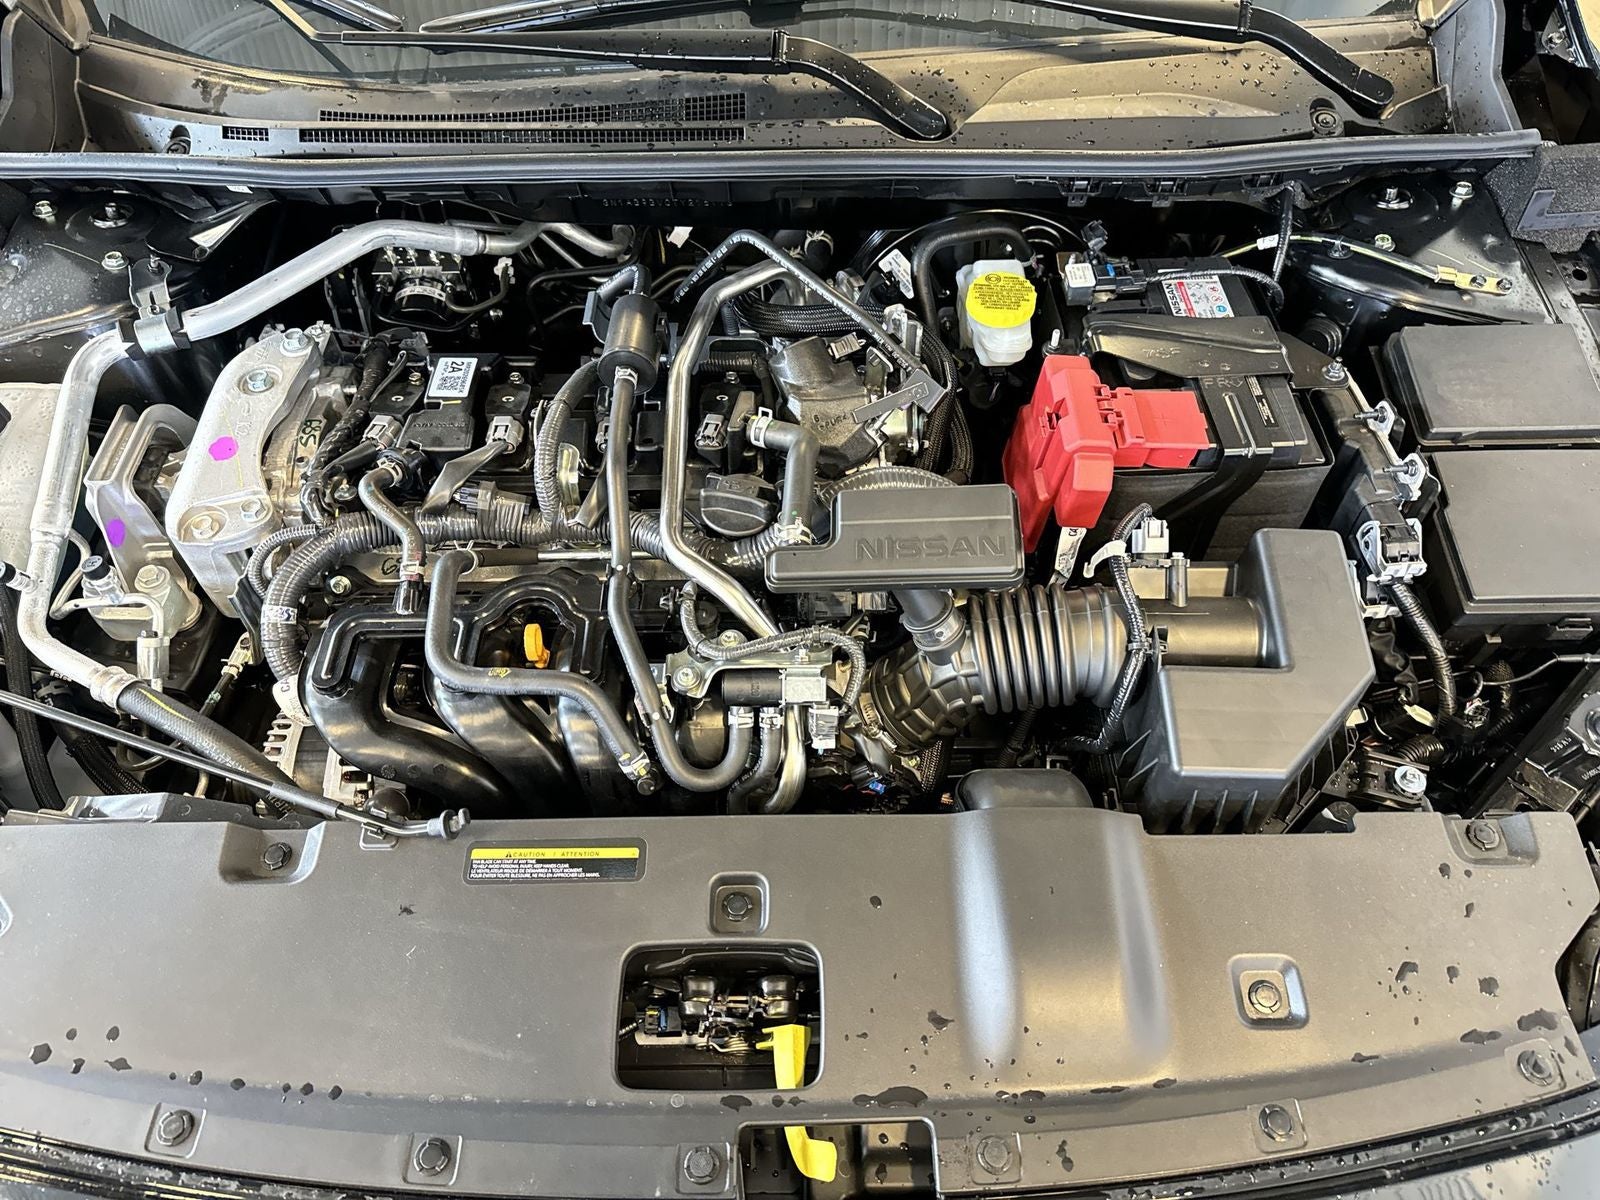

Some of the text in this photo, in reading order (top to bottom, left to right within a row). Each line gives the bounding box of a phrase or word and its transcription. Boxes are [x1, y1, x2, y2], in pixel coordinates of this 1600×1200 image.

[1164, 282, 1183, 315] NISSAN
[448, 361, 464, 374] 2A
[854, 534, 1006, 561] NISSAN
